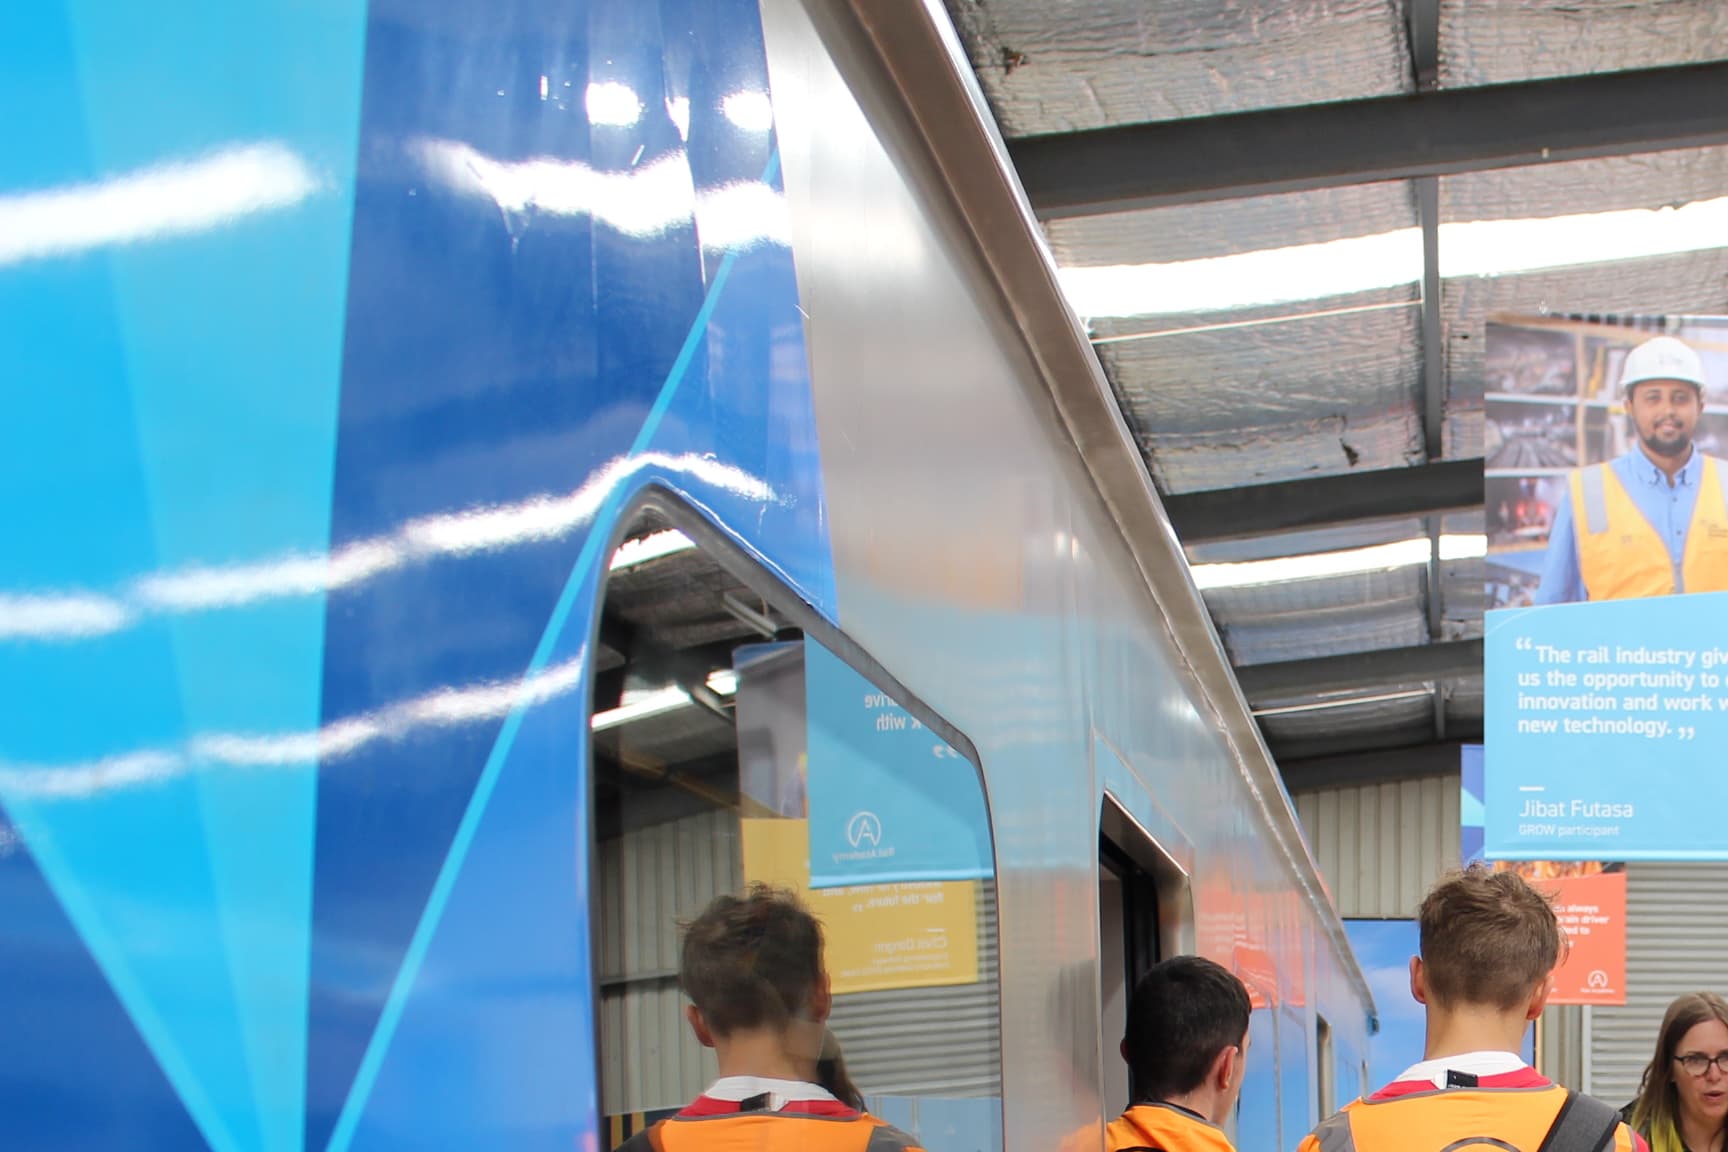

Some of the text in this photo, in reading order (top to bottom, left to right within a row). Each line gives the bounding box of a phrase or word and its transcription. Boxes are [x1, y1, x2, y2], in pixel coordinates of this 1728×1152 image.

[1577, 647, 1610, 663] rail
[1616, 647, 1696, 668] industry
[1518, 673, 1540, 686] us
[1547, 670, 1577, 687] the
[1584, 672, 1694, 691] opportunity
[1700, 674, 1719, 688] to
[1518, 693, 1617, 710] innovation
[1623, 694, 1658, 710] and
[1664, 695, 1712, 711] work
[1518, 719, 1558, 733] new
[1519, 800, 1633, 818] Jibat Futasa
[1519, 824, 1619, 838] GROW participant
